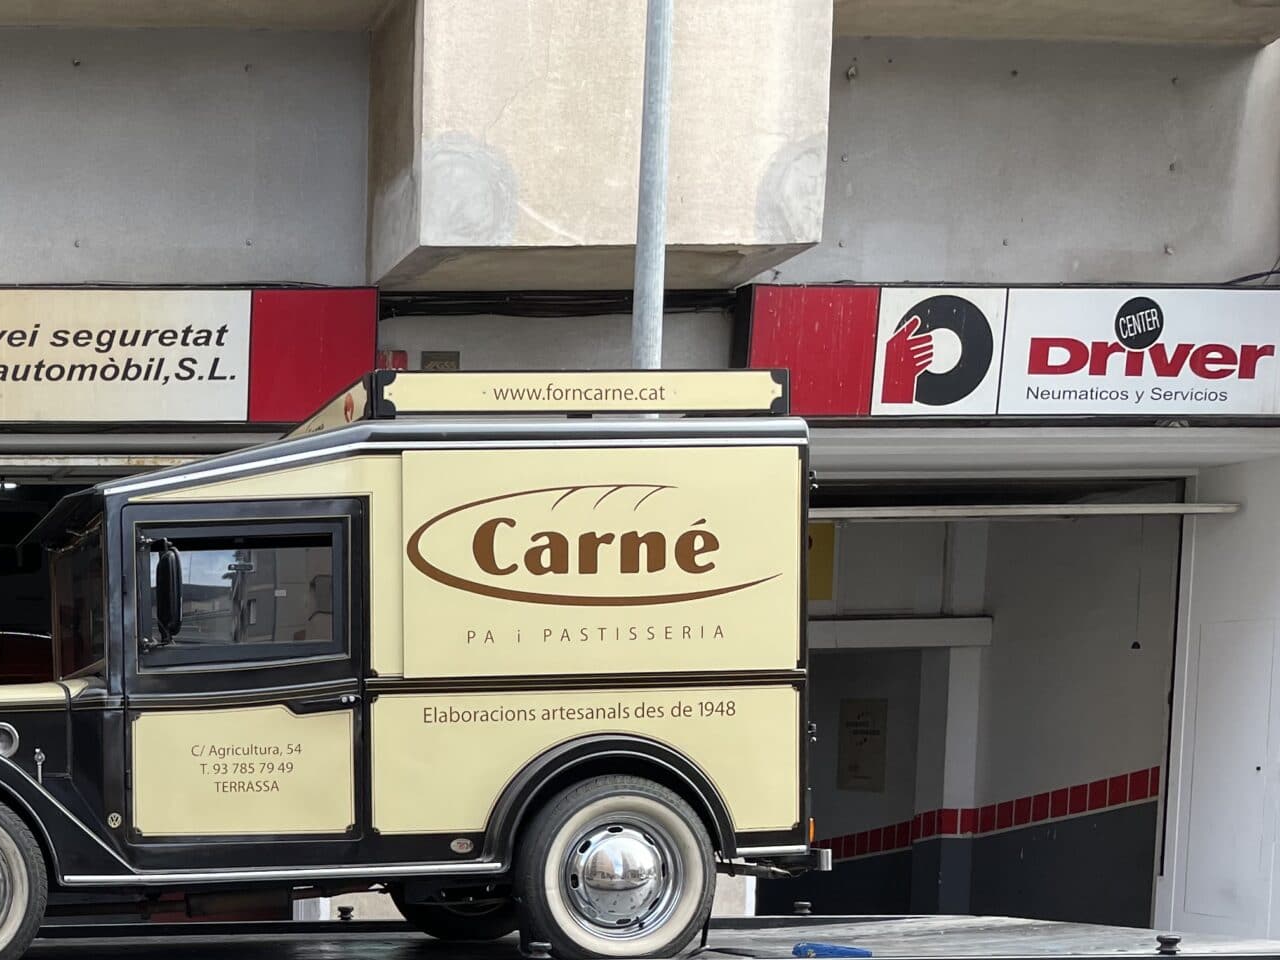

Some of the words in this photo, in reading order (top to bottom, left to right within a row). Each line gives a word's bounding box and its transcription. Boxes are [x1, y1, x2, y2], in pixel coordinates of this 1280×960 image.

[1118, 308, 1161, 340] CENTER
[49, 323, 230, 353] seguretat
[1027, 337, 1276, 380] Driver
[493, 383, 666, 401] www.forncarne.cat
[1026, 386, 1129, 401] Neumaticos
[1135, 390, 1145, 404] y
[1150, 387, 1228, 402] Servicios
[472, 517, 720, 576] Carné
[467, 630, 495, 644] PA
[543, 625, 725, 643] PASTISSERIA
[422, 704, 536, 723] Elaboracions
[541, 703, 630, 722] artesanals
[634, 702, 665, 719] des
[670, 701, 693, 718] de
[698, 701, 736, 717] 1948
[191, 744, 206, 757] C/
[208, 744, 283, 759] Agricultura,
[287, 743, 302, 755] 54
[200, 763, 210, 775] T.
[212, 763, 228, 775] 93
[232, 762, 255, 774] 785
[259, 762, 275, 774] 79
[277, 762, 294, 773] 49
[214, 780, 280, 792] TERRASSA
